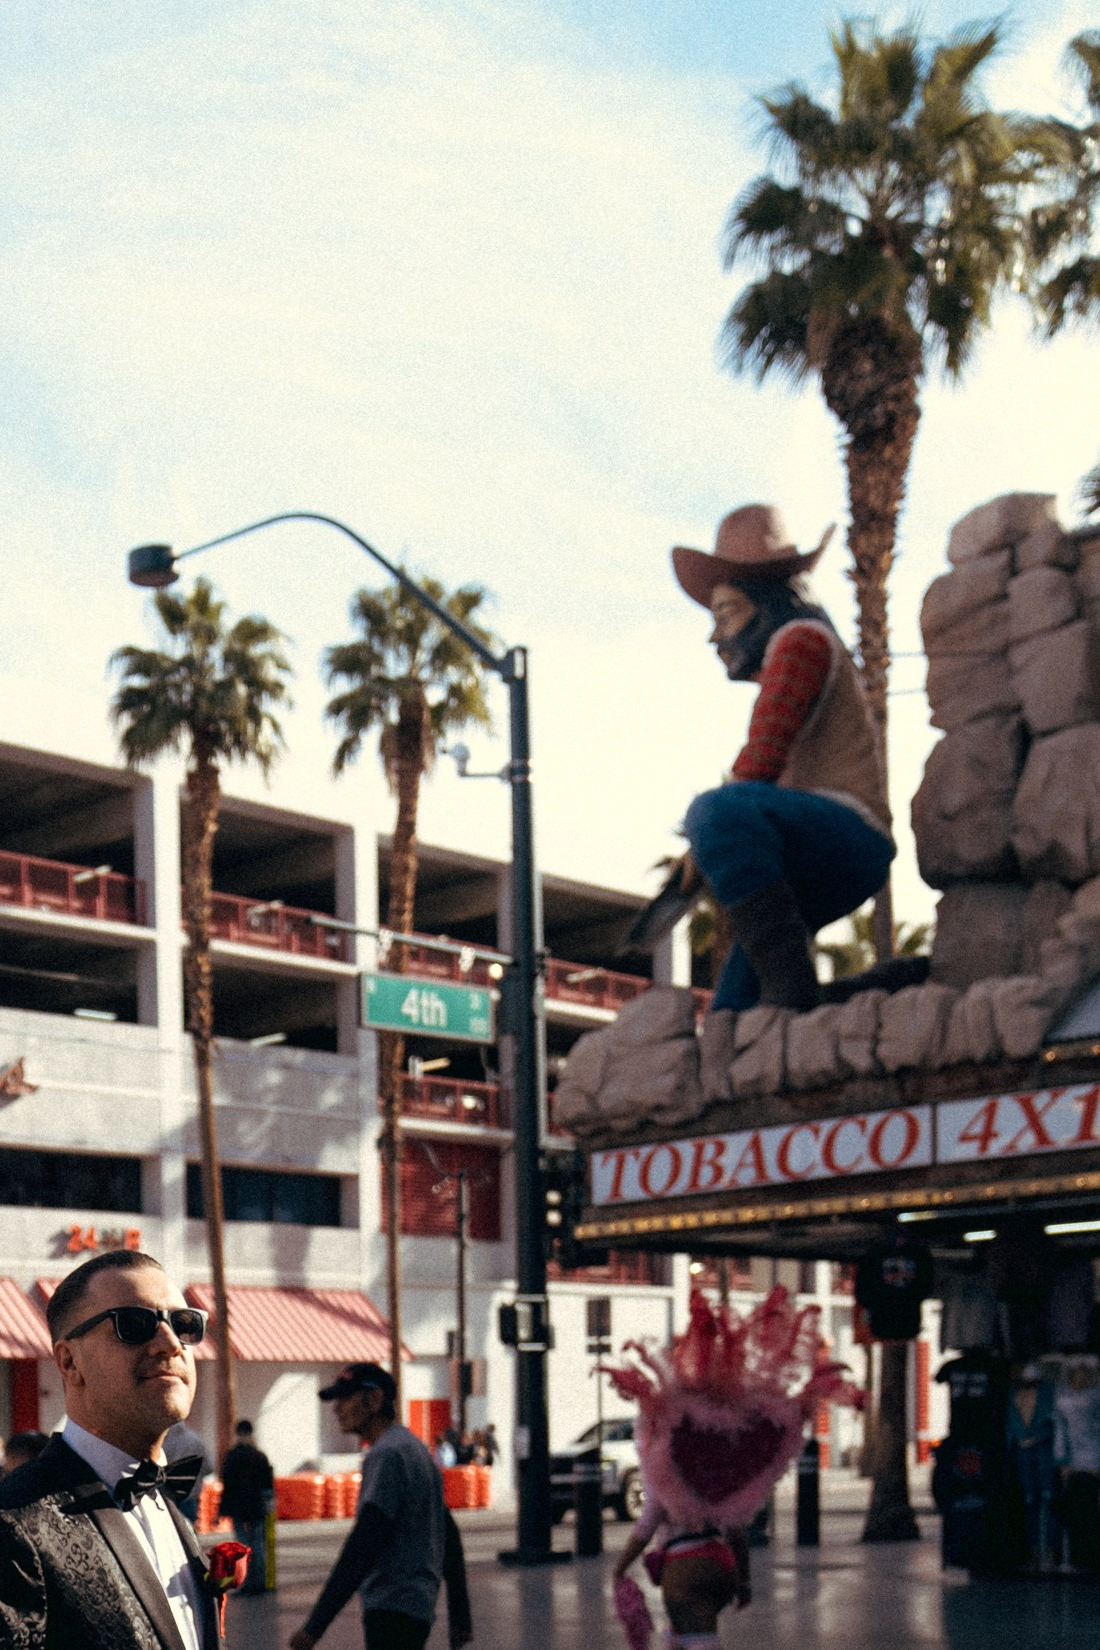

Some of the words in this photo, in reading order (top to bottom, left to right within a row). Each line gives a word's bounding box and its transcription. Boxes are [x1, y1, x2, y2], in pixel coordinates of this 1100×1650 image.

[401, 988, 448, 1027] 4th
[602, 1107, 921, 1200] TOBACCO
[68, 1224, 98, 1252] 24
